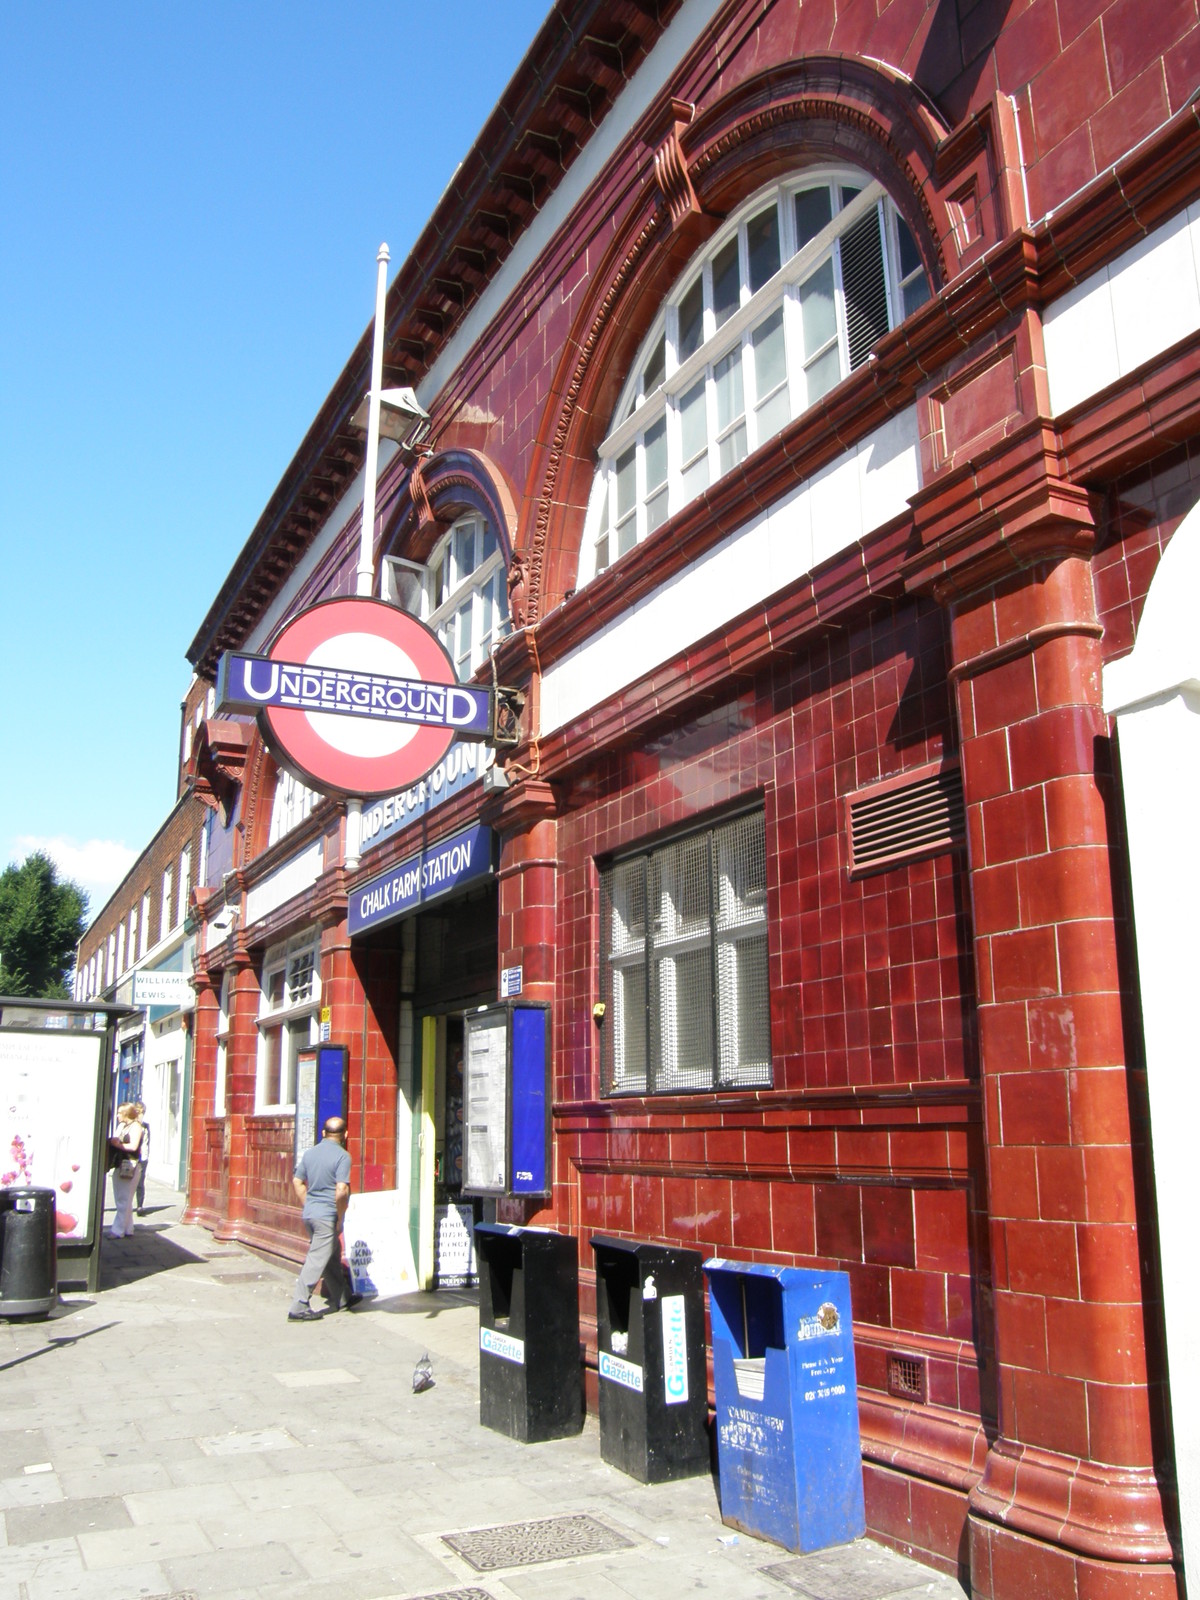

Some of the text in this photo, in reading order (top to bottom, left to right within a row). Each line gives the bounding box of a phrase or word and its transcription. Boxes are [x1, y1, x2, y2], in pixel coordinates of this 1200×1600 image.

[243, 660, 478, 725] UNDERGROUND
[361, 741, 496, 844] NDERGROUND
[360, 840, 472, 919] CHALK FARM STATION
[135, 991, 166, 999] LEWIS
[482, 1330, 522, 1361] Gazette
[601, 1354, 641, 1388] Gazette
